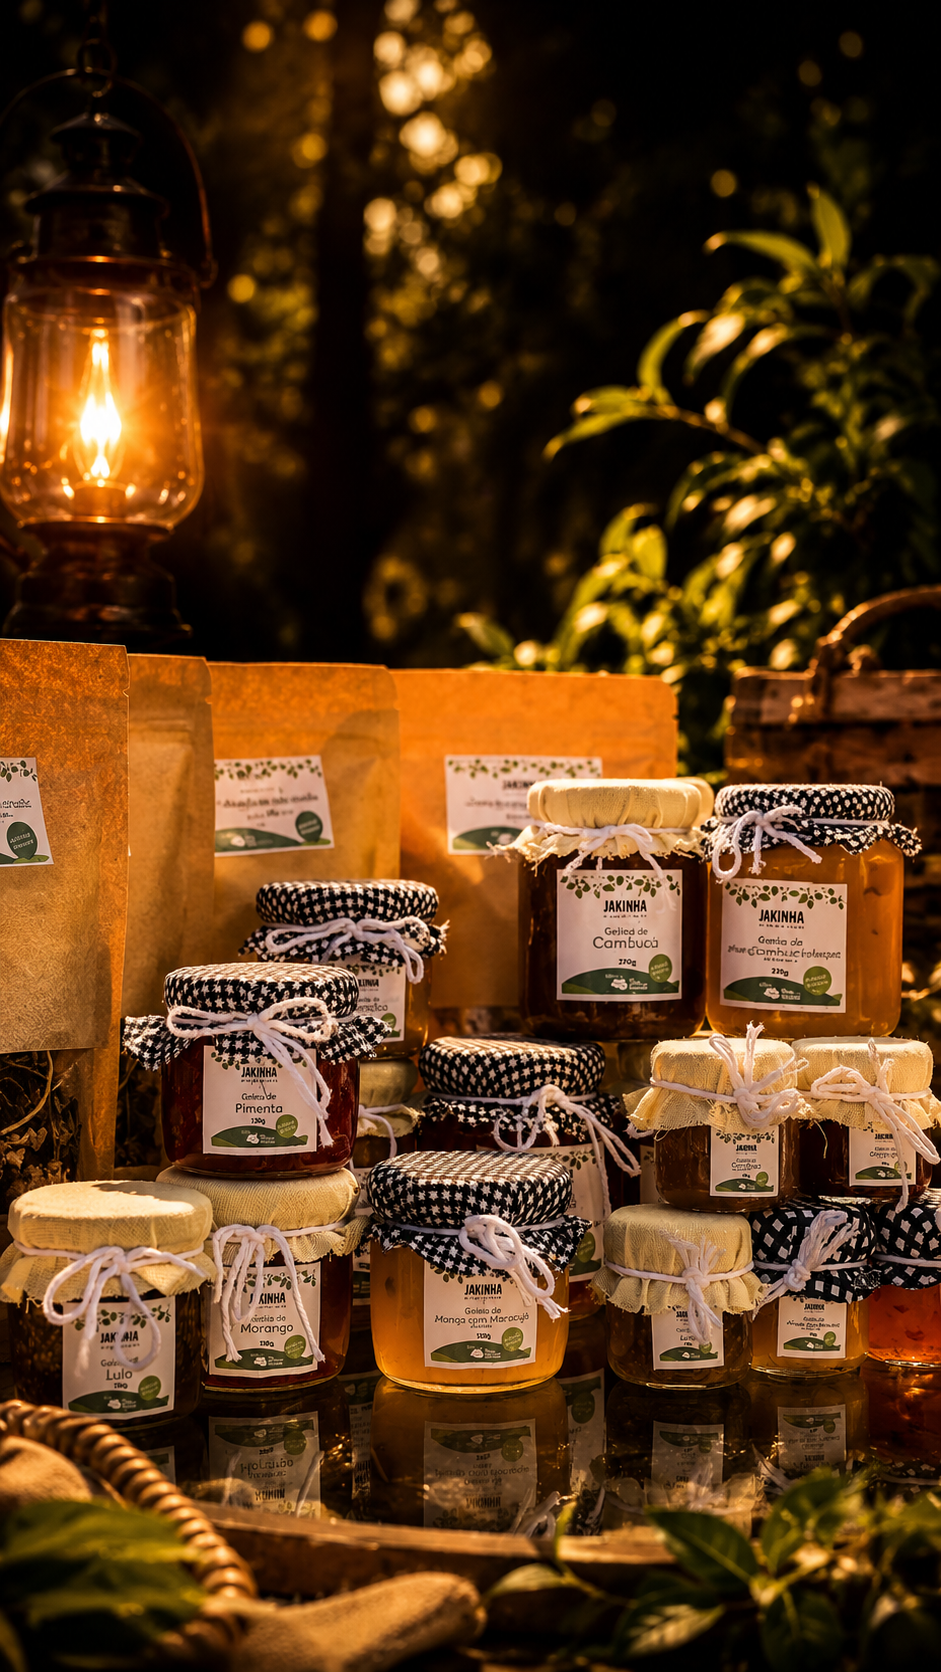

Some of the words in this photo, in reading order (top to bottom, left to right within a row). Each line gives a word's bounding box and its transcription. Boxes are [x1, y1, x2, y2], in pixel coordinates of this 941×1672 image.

[603, 900, 647, 912] JAKINHA
[758, 909, 804, 924] JAKINHA
[235, 1103, 283, 1114] Pimenta
[464, 1283, 502, 1296] JAKINHA
[249, 1292, 286, 1305] JKINHA
[240, 1324, 294, 1336] Morango
[105, 1368, 133, 1381] Lulo
